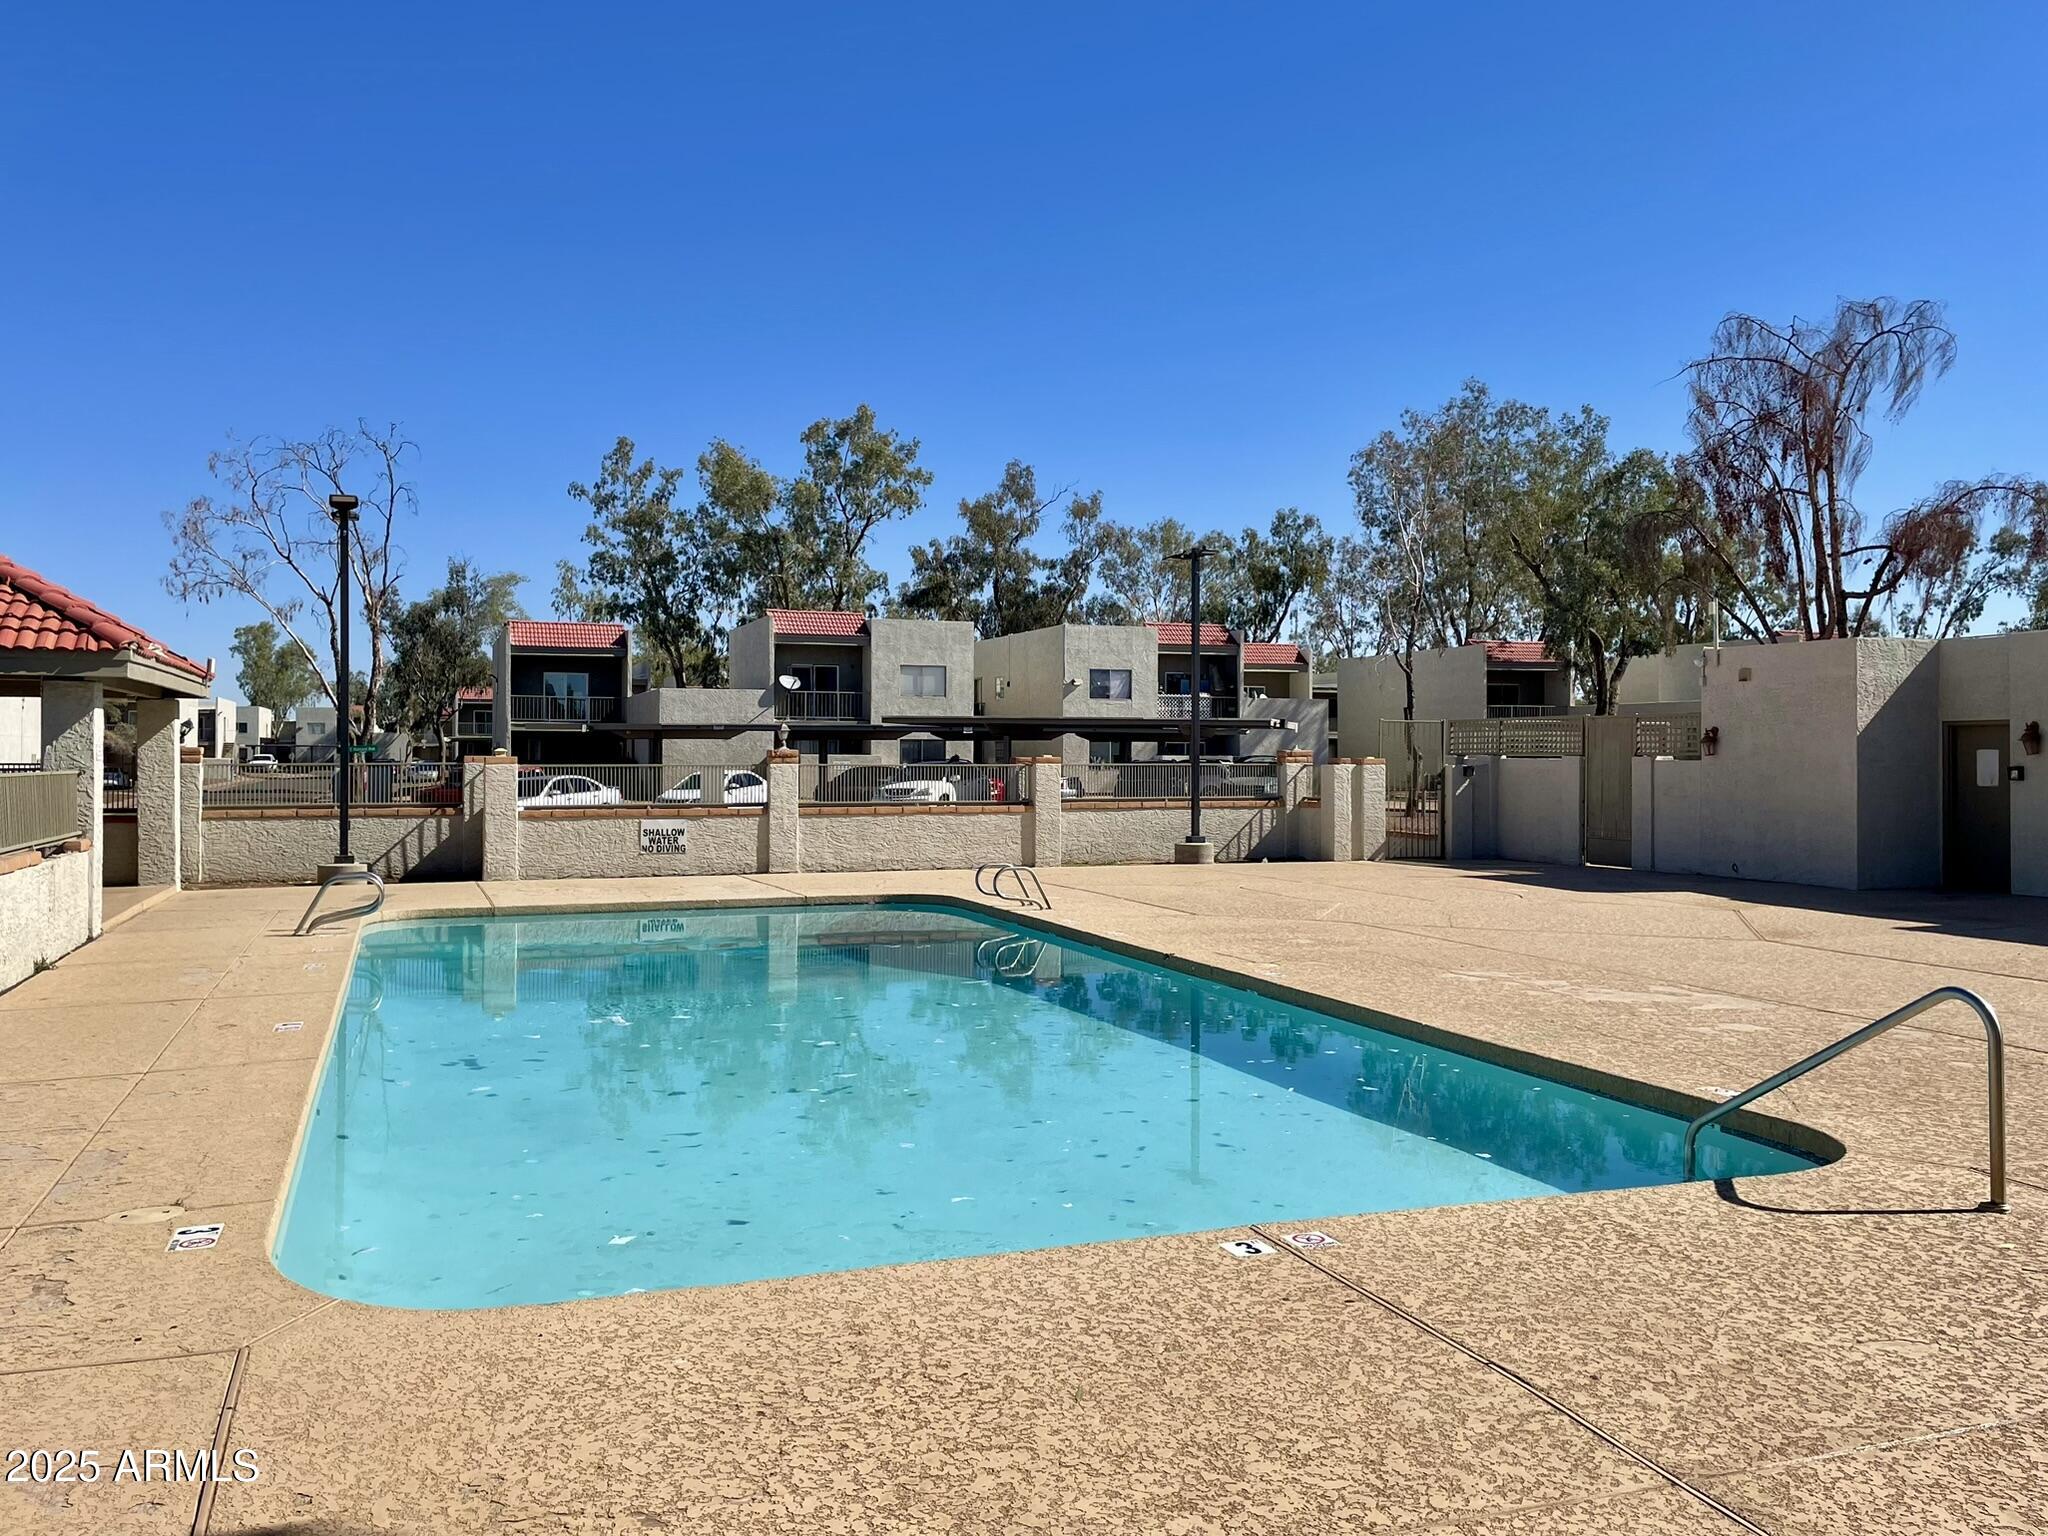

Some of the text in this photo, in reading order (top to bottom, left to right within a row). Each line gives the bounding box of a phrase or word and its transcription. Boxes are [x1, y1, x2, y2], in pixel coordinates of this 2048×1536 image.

[642, 828, 685, 837] SHALLOW
[648, 837, 679, 845] WATER
[641, 845, 686, 853] NO DIVING
[1235, 1242, 1262, 1254] 3
